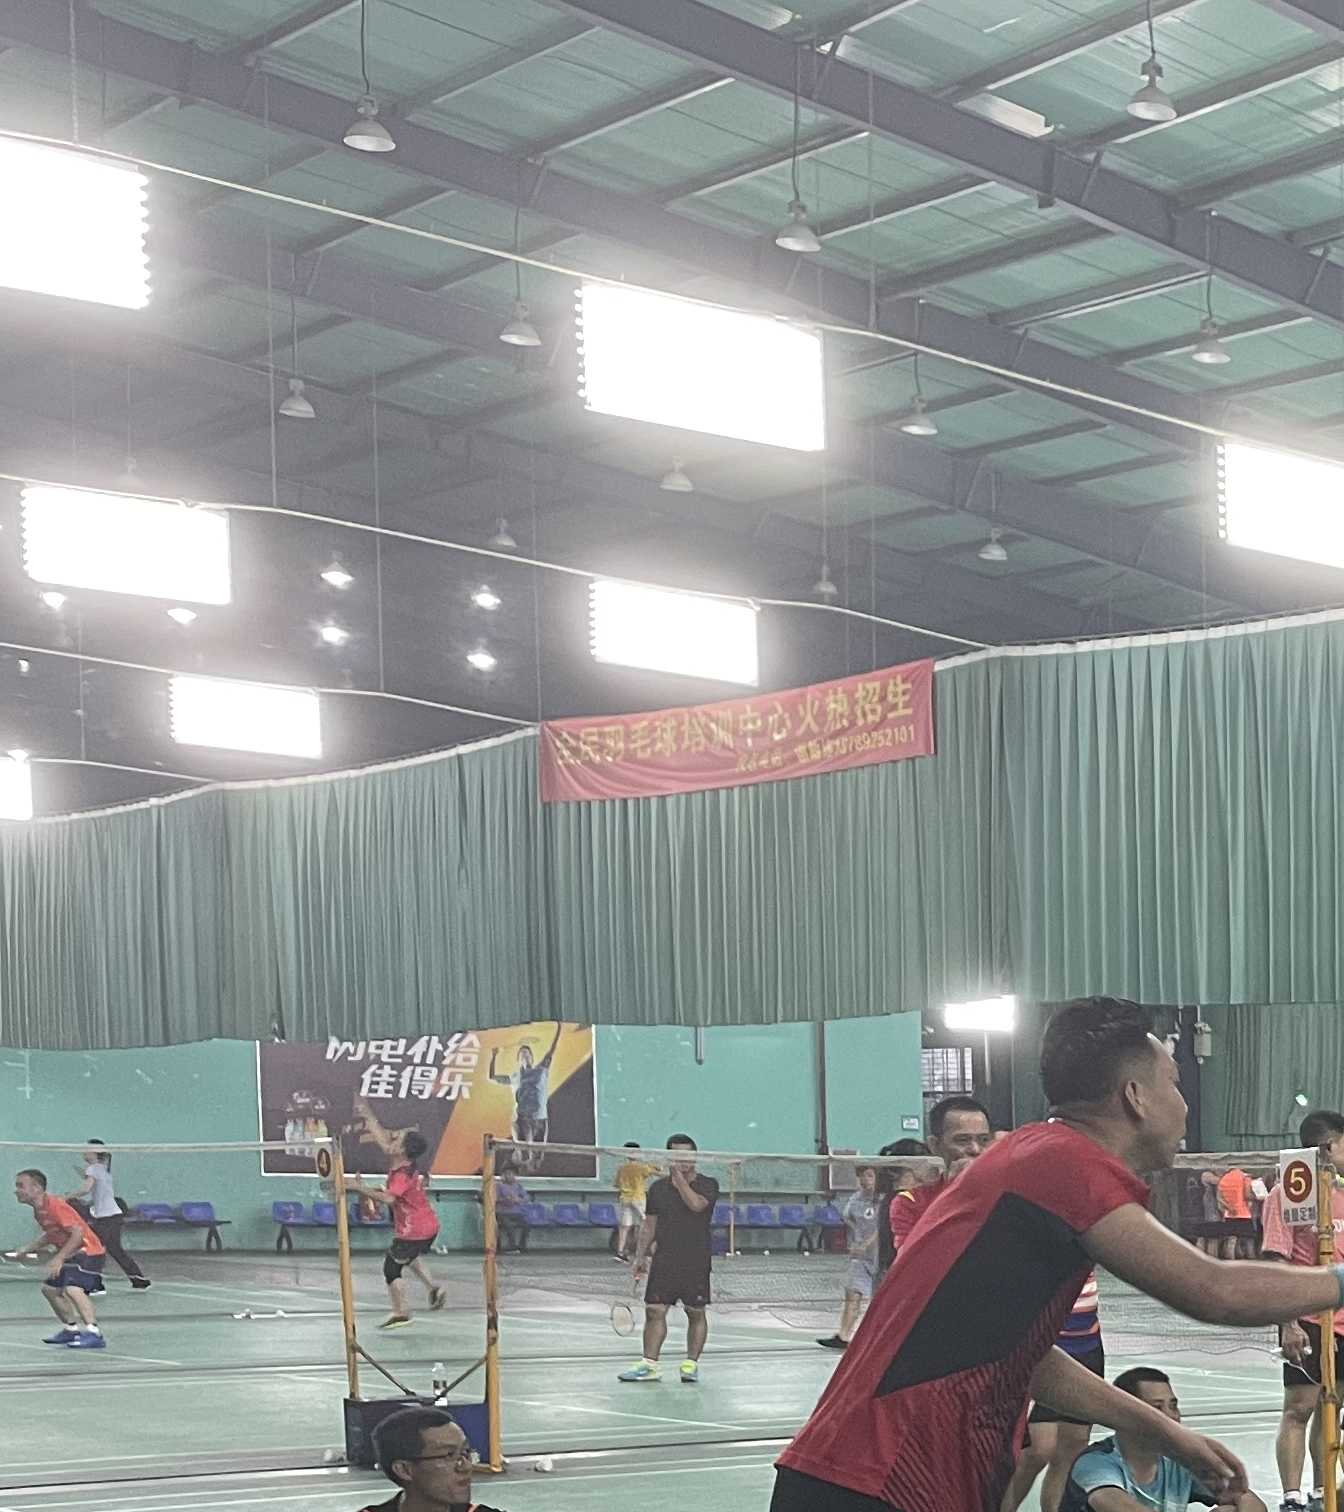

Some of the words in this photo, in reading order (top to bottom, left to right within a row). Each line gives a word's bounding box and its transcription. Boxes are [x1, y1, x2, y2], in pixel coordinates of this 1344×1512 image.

[360, 1065, 475, 1100] 佳得乐
[1290, 1167, 1306, 1195] 5
